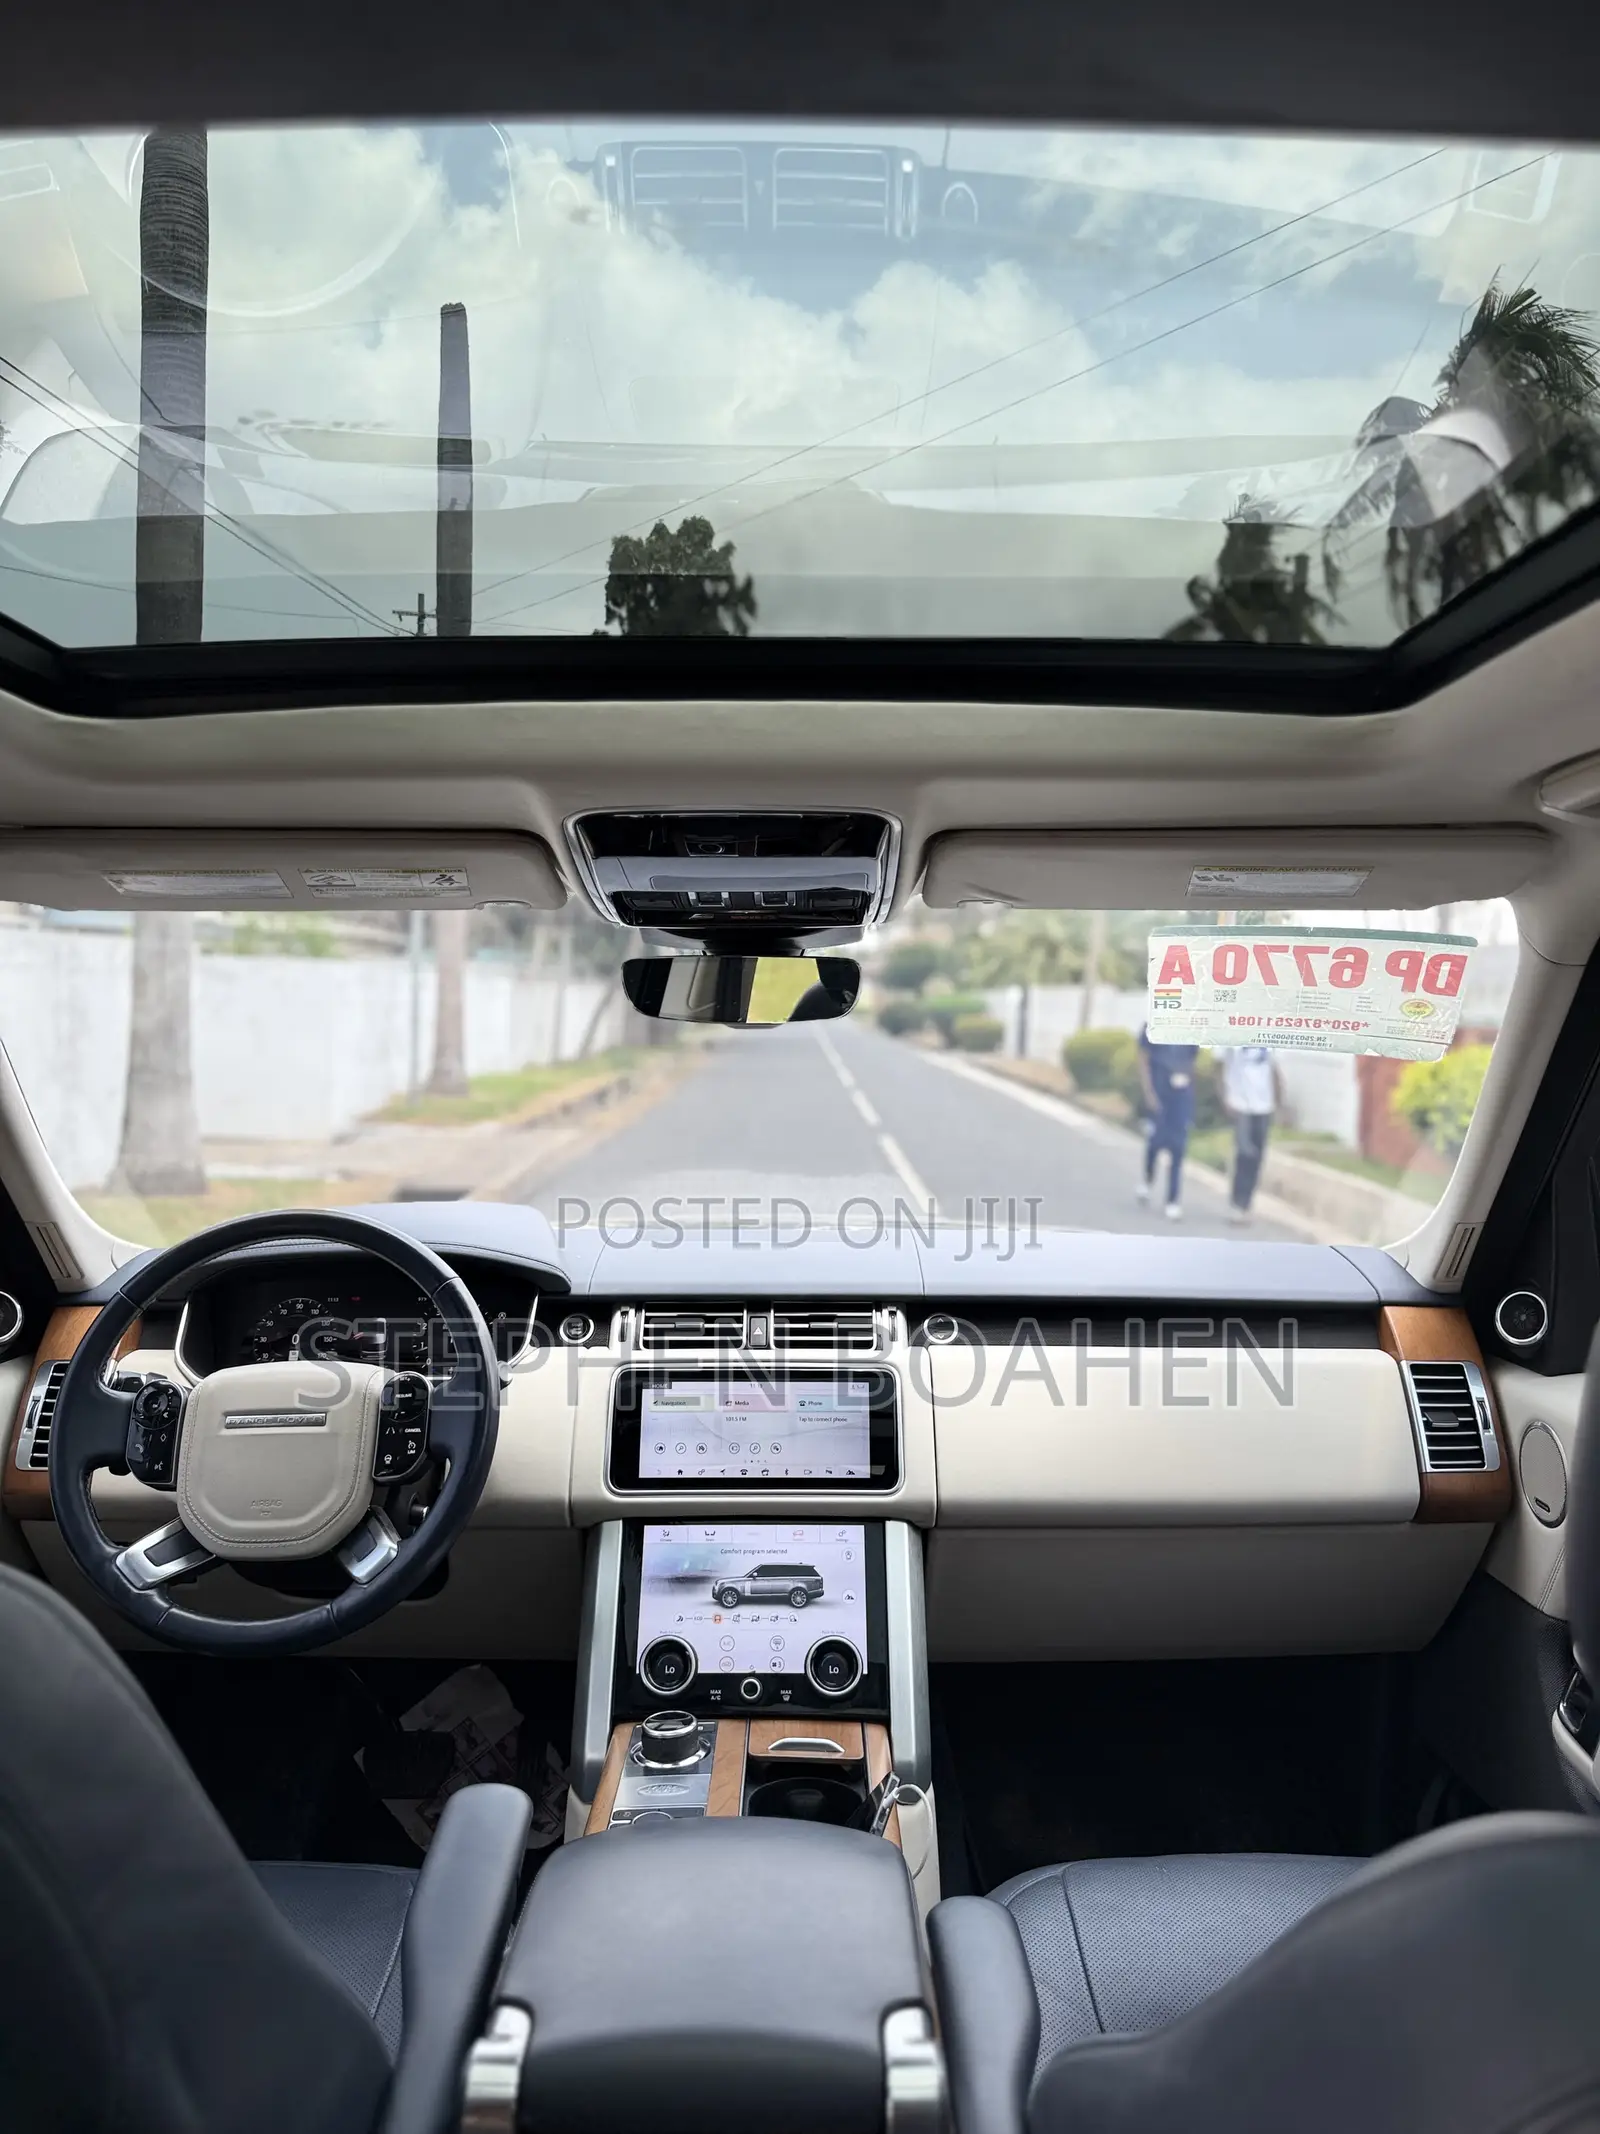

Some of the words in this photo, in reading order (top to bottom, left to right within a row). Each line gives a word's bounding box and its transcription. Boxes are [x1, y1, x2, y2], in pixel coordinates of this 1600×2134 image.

[422, 1322, 428, 1330] 2
[291, 1333, 300, 1345] 0
[743, 1548, 765, 1556] program
